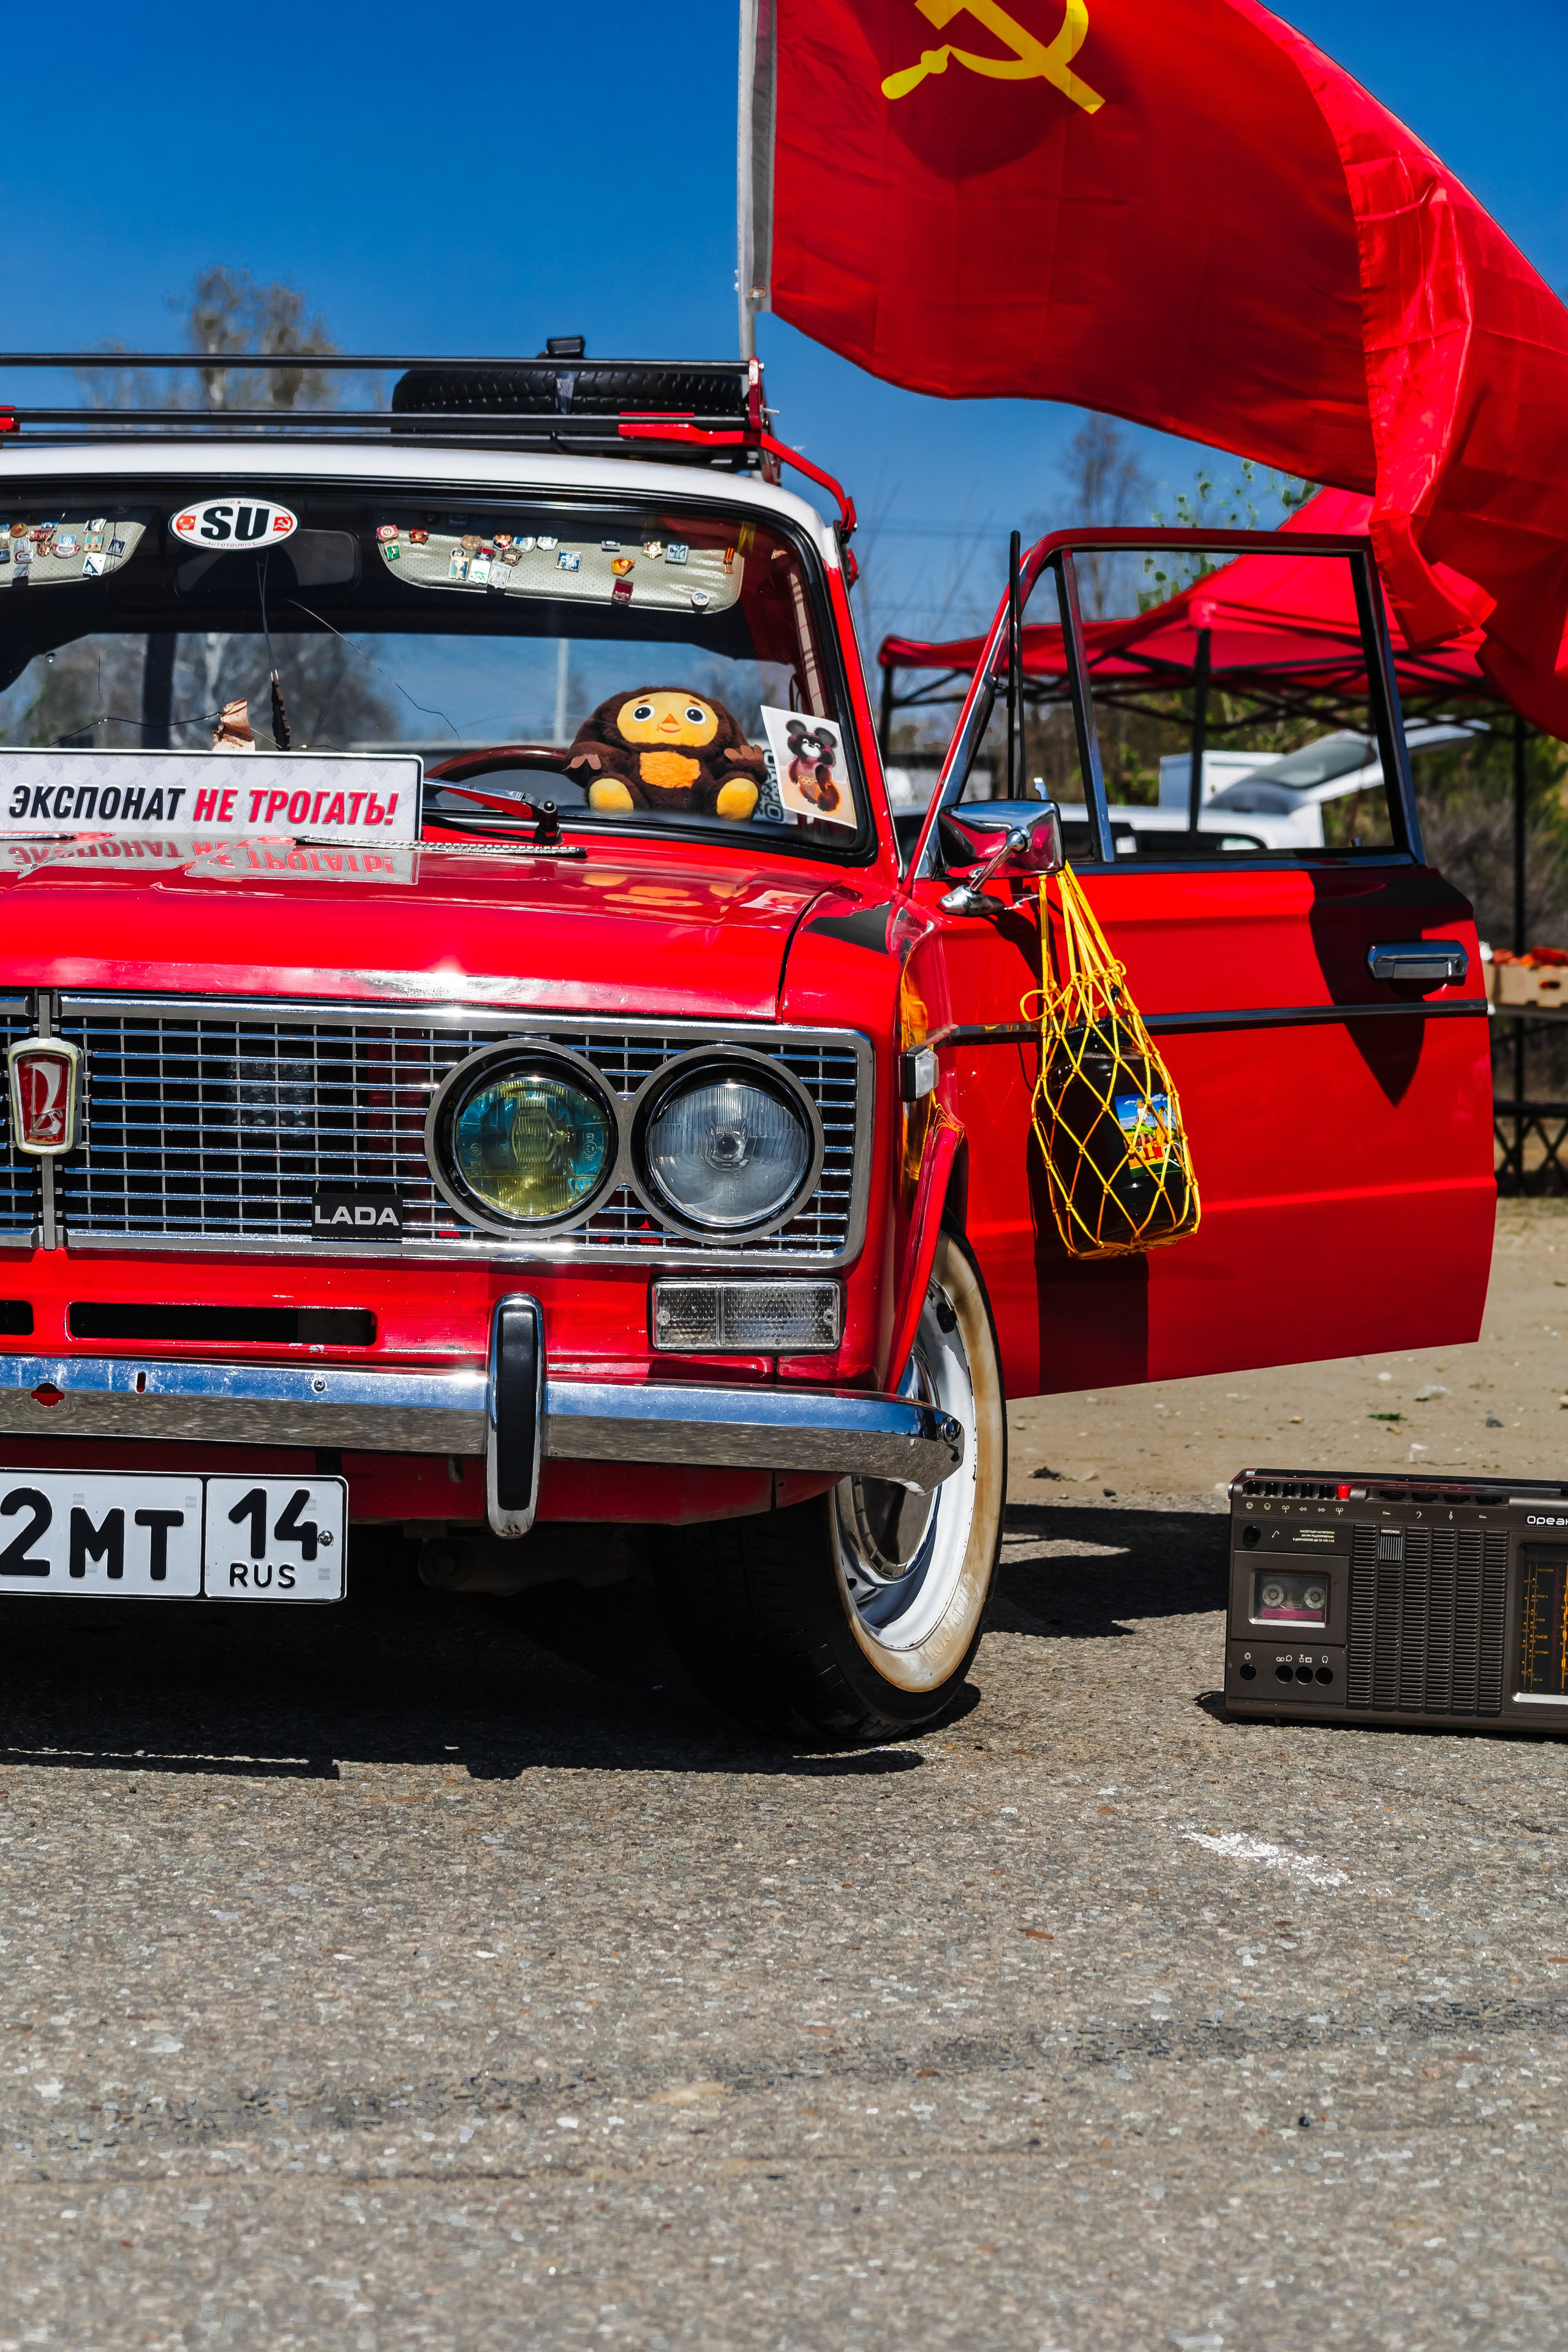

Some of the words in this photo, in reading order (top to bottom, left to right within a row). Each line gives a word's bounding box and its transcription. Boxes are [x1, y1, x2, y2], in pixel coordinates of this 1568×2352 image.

[201, 506, 270, 541] SU
[9, 784, 187, 820] ЭКСПОНАТ
[193, 788, 238, 822] НЕ
[249, 789, 399, 825] ТРОГАТЬ!
[315, 1205, 399, 1226] LADA
[228, 1488, 318, 1561] 14
[230, 1562, 295, 1588] RUS
[925, 1572, 981, 1661] CHAMPION
